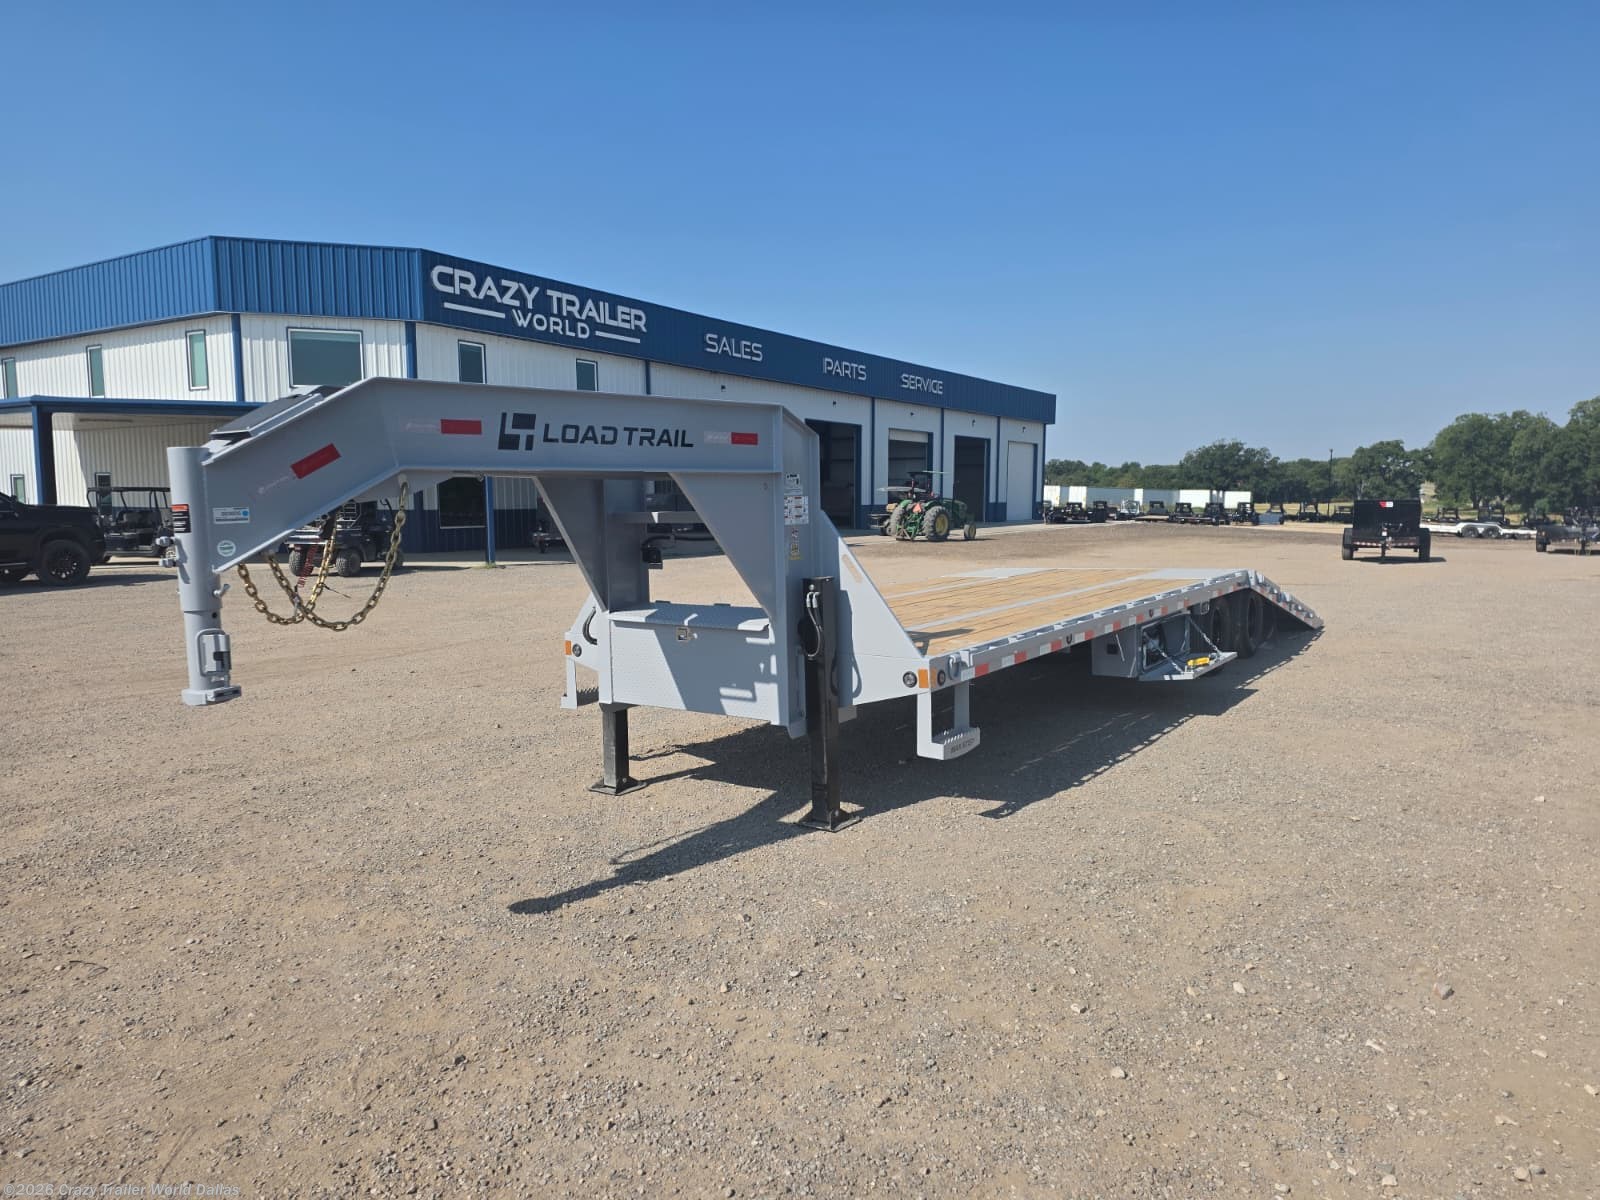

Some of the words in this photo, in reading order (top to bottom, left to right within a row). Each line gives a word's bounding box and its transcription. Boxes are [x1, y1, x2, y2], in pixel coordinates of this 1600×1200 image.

[431, 264, 540, 310] CRAZY
[546, 289, 648, 333] TRAILER
[511, 308, 591, 339] WORLD
[704, 333, 764, 362] SALES
[822, 356, 868, 382] PARTS
[900, 373, 944, 395] SERVICE
[542, 423, 619, 445] LOAD
[622, 426, 695, 449] TRAIL
